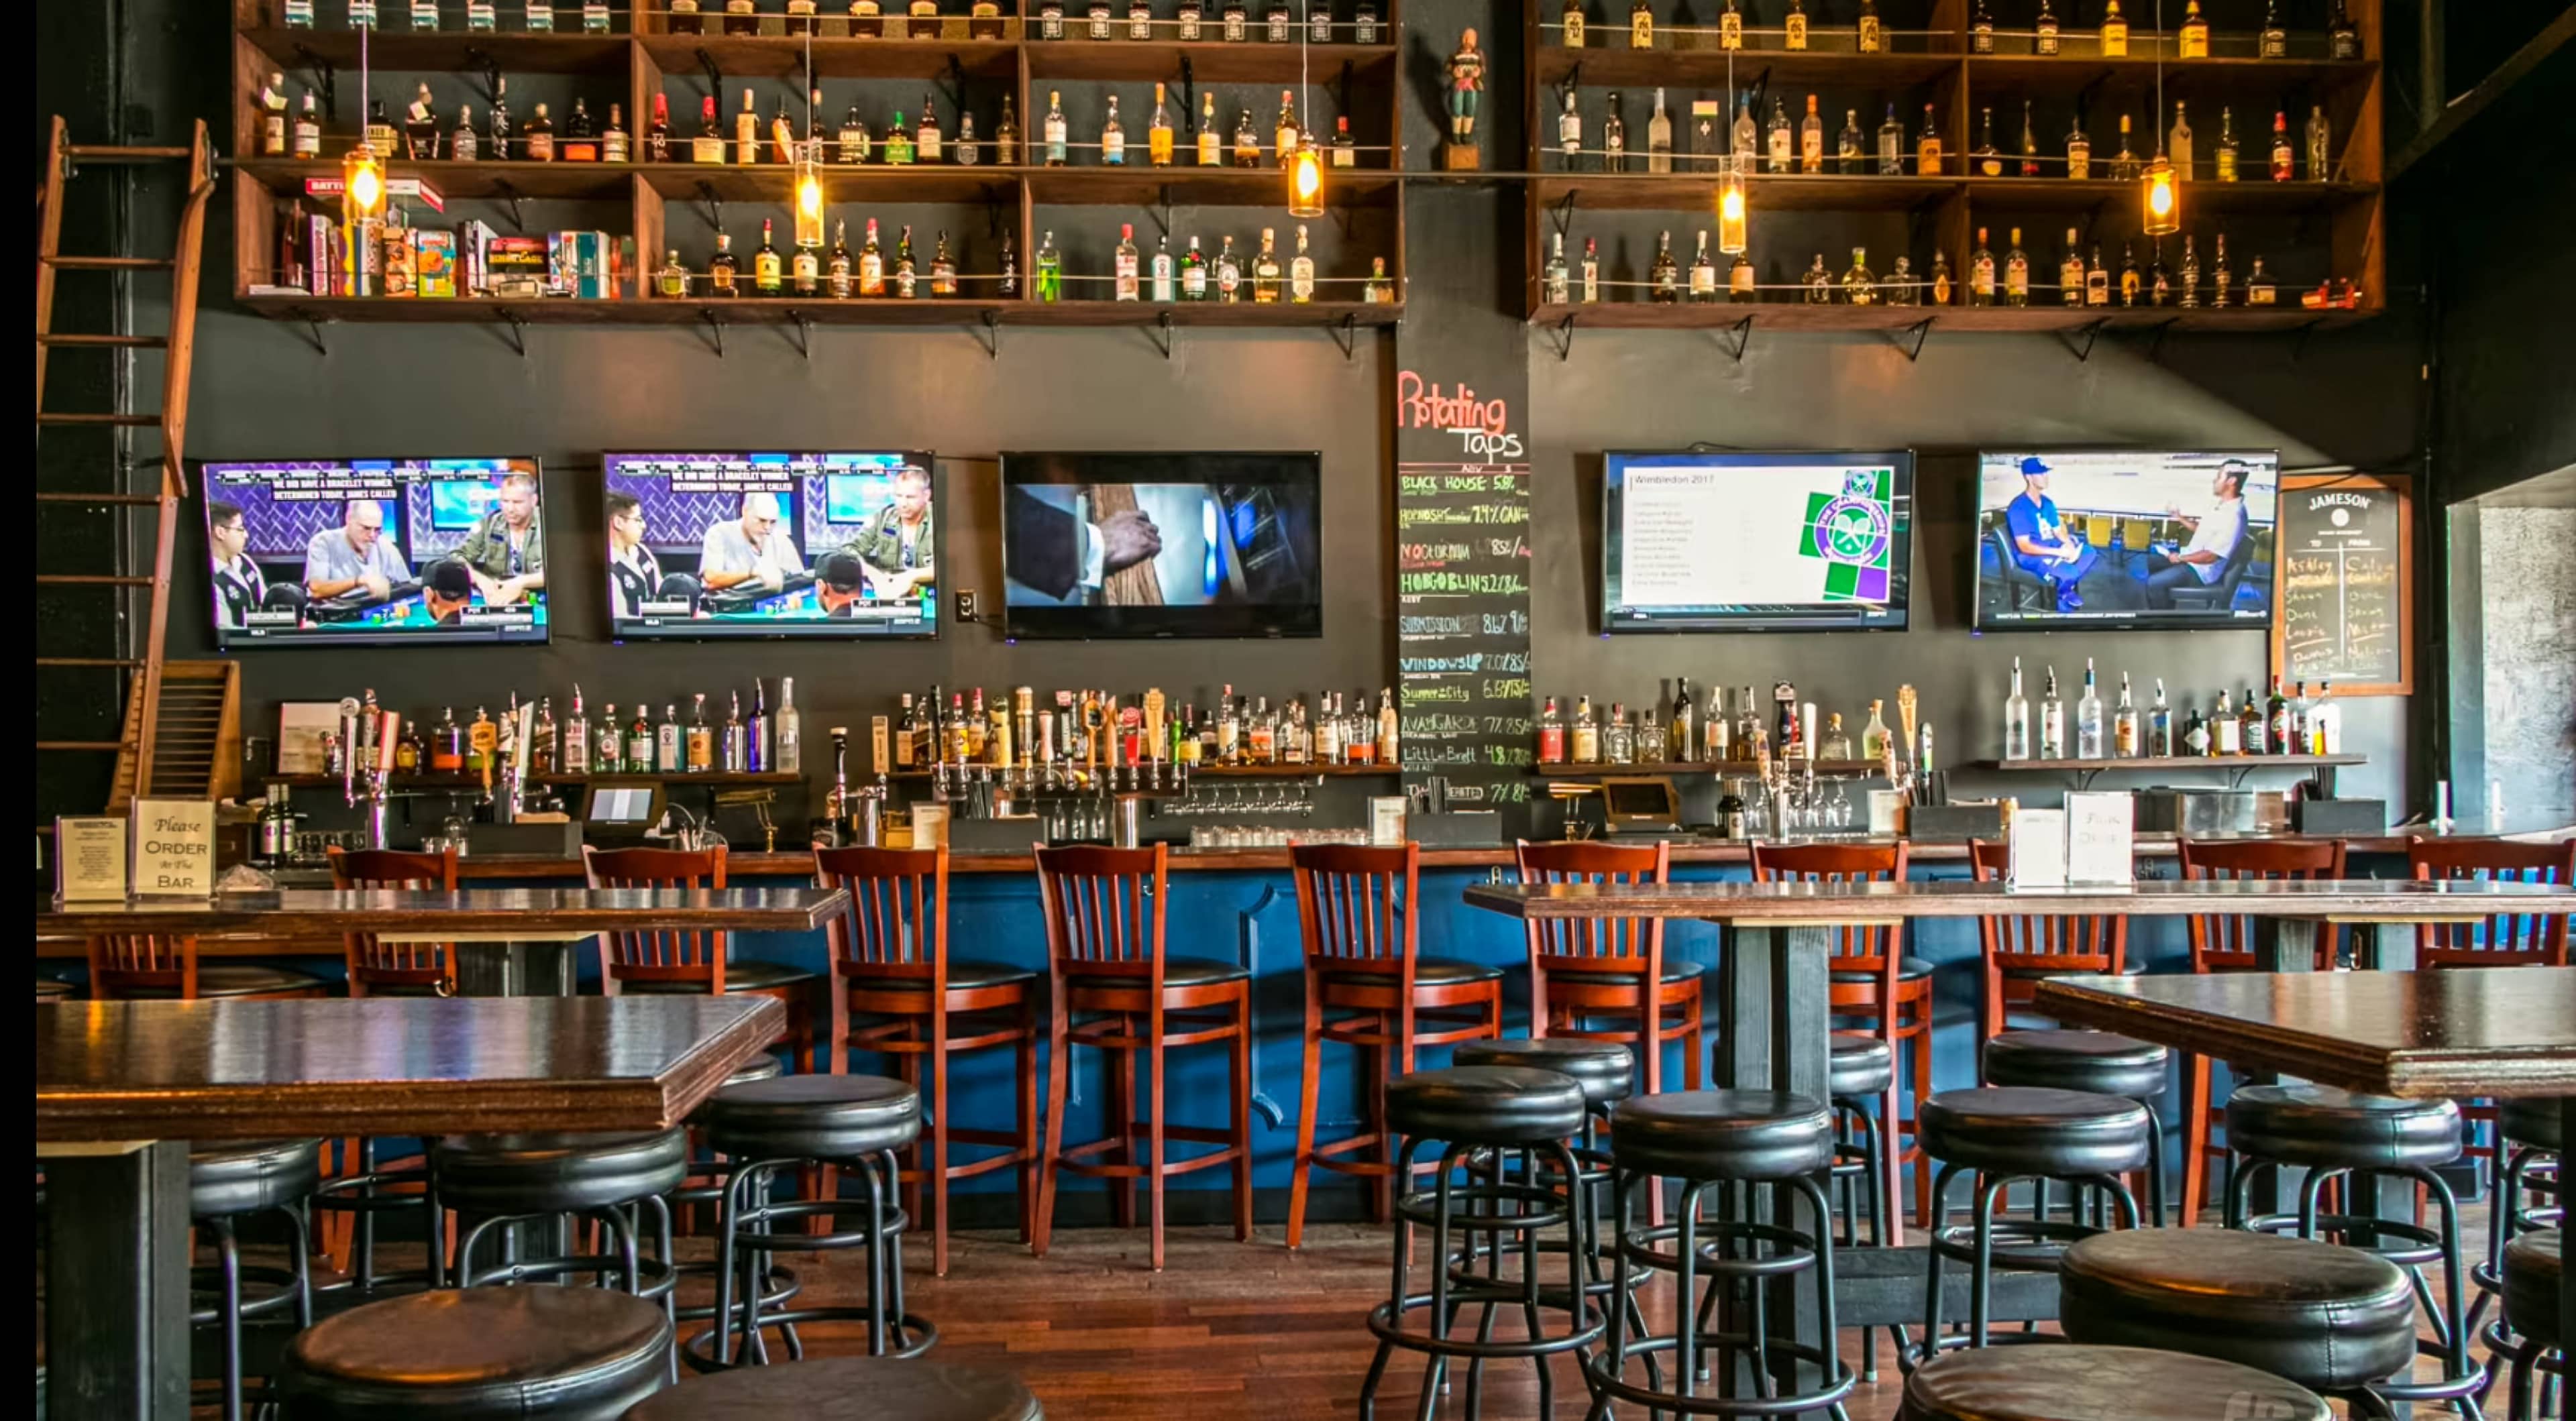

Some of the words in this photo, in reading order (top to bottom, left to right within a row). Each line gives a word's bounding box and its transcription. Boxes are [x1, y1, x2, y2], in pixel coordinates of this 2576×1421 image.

[1398, 370, 1507, 437] Rotating
[1447, 428, 1523, 464] Taps
[1401, 475, 1438, 490] BLACK
[1445, 475, 1487, 491] HOUSE
[1635, 474, 1688, 485] Wimbledon
[1691, 474, 1715, 484] 2017
[2309, 493, 2370, 511] JAMESON
[1401, 572, 1481, 593] HOBGOBLIN
[154, 815, 201, 832] Please
[145, 840, 207, 855] ORDER
[158, 874, 194, 889] BAR
